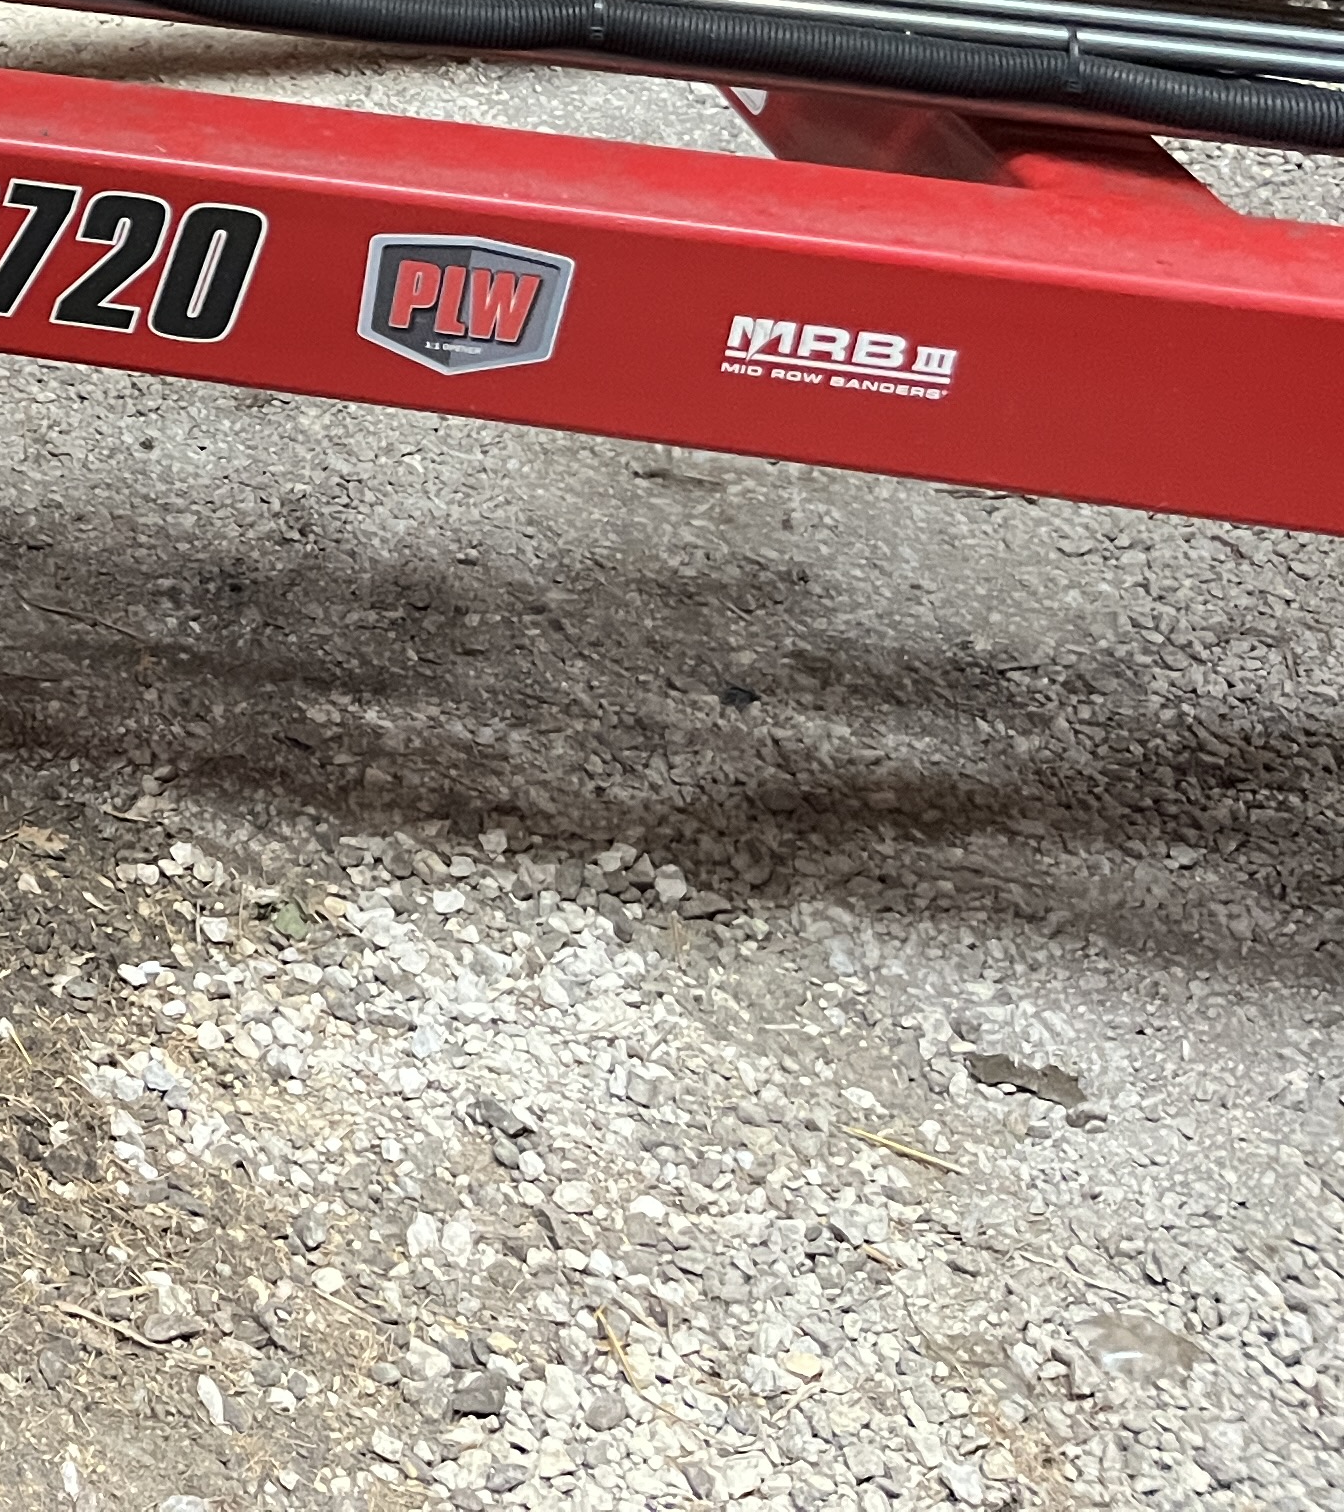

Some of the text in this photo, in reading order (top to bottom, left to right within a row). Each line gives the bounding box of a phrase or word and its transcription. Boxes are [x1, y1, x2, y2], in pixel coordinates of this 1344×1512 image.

[388, 259, 542, 343] PLW
[720, 362, 763, 376] MID
[771, 368, 823, 384] ROW
[726, 315, 958, 375] MRB III
